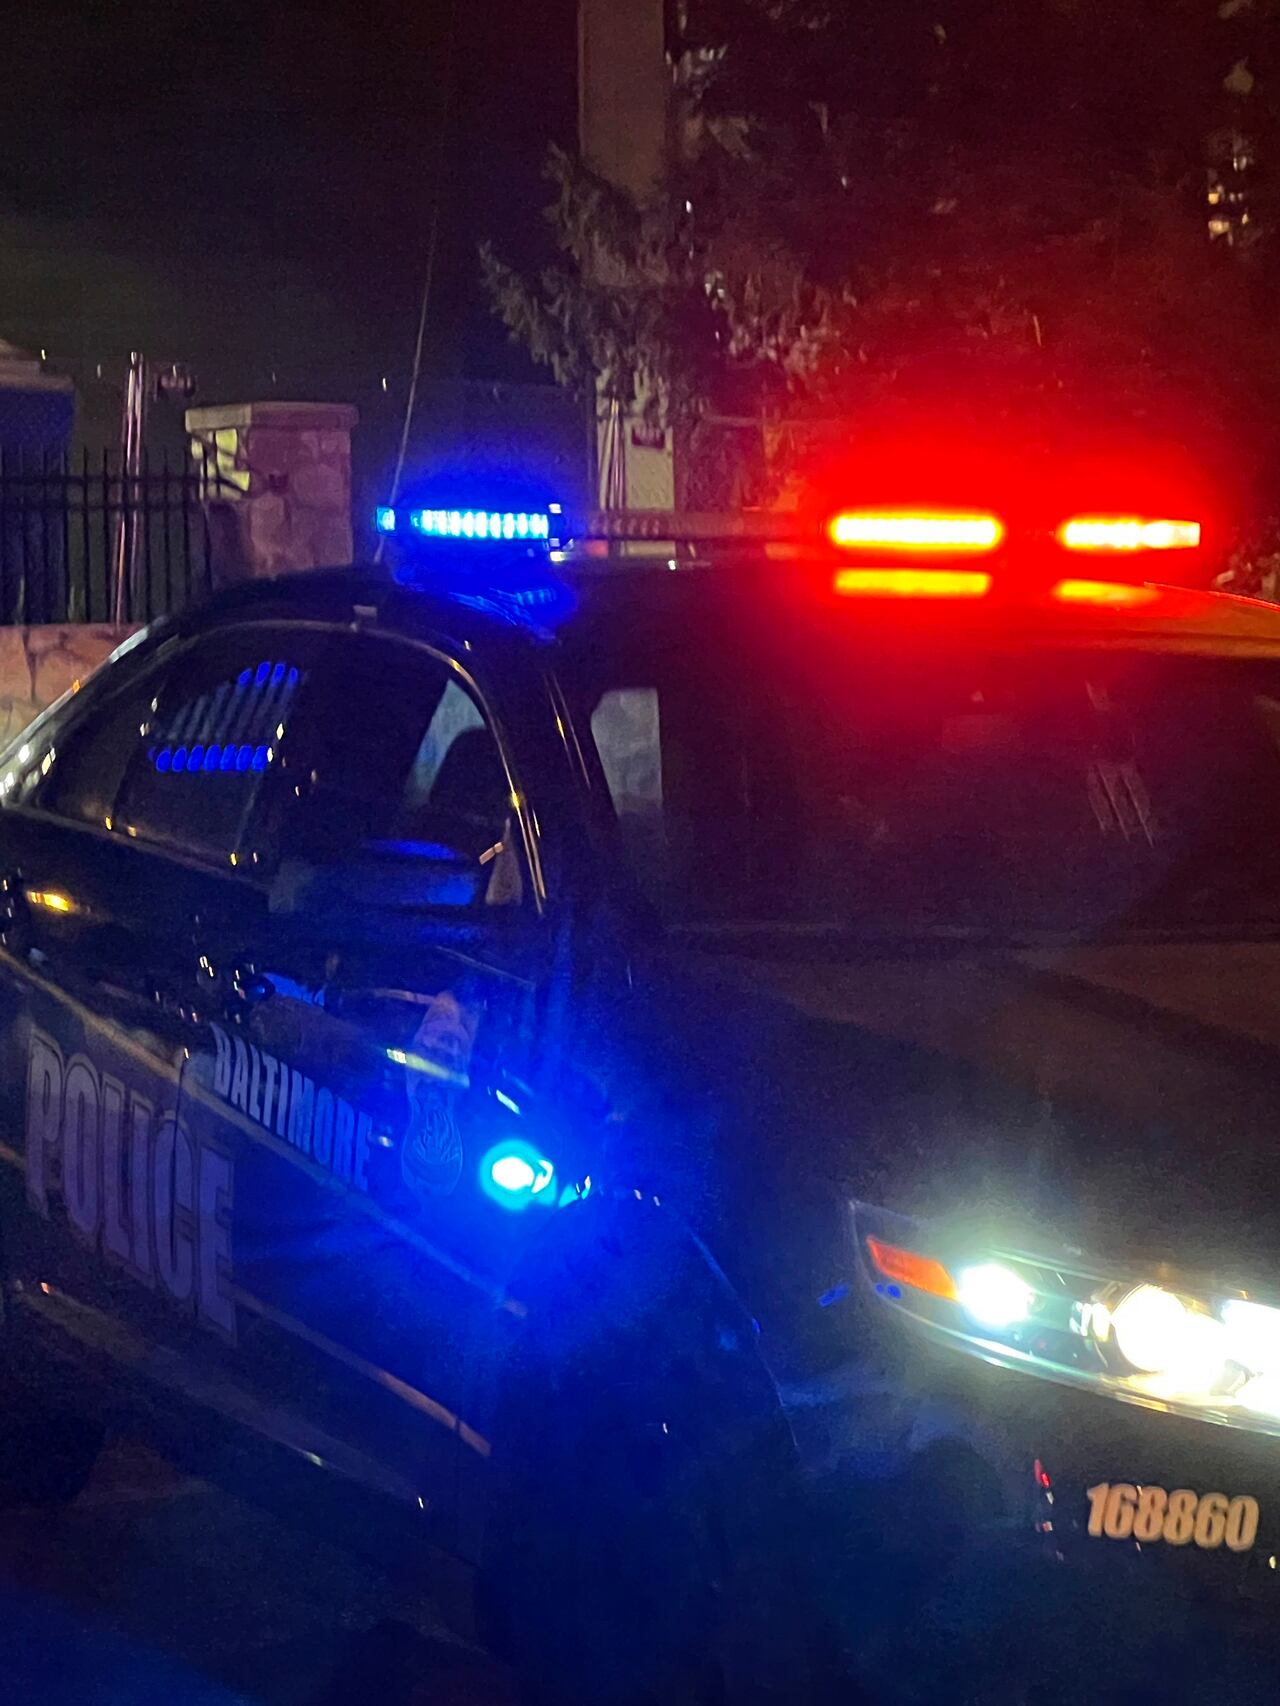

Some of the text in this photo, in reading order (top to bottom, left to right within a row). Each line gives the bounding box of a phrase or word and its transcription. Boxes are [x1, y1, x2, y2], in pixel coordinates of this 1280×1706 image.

[25, 1022, 238, 1347] POLICE
[210, 1021, 373, 1194] BALTIMORE
[1086, 1482, 1260, 1552] 168860
